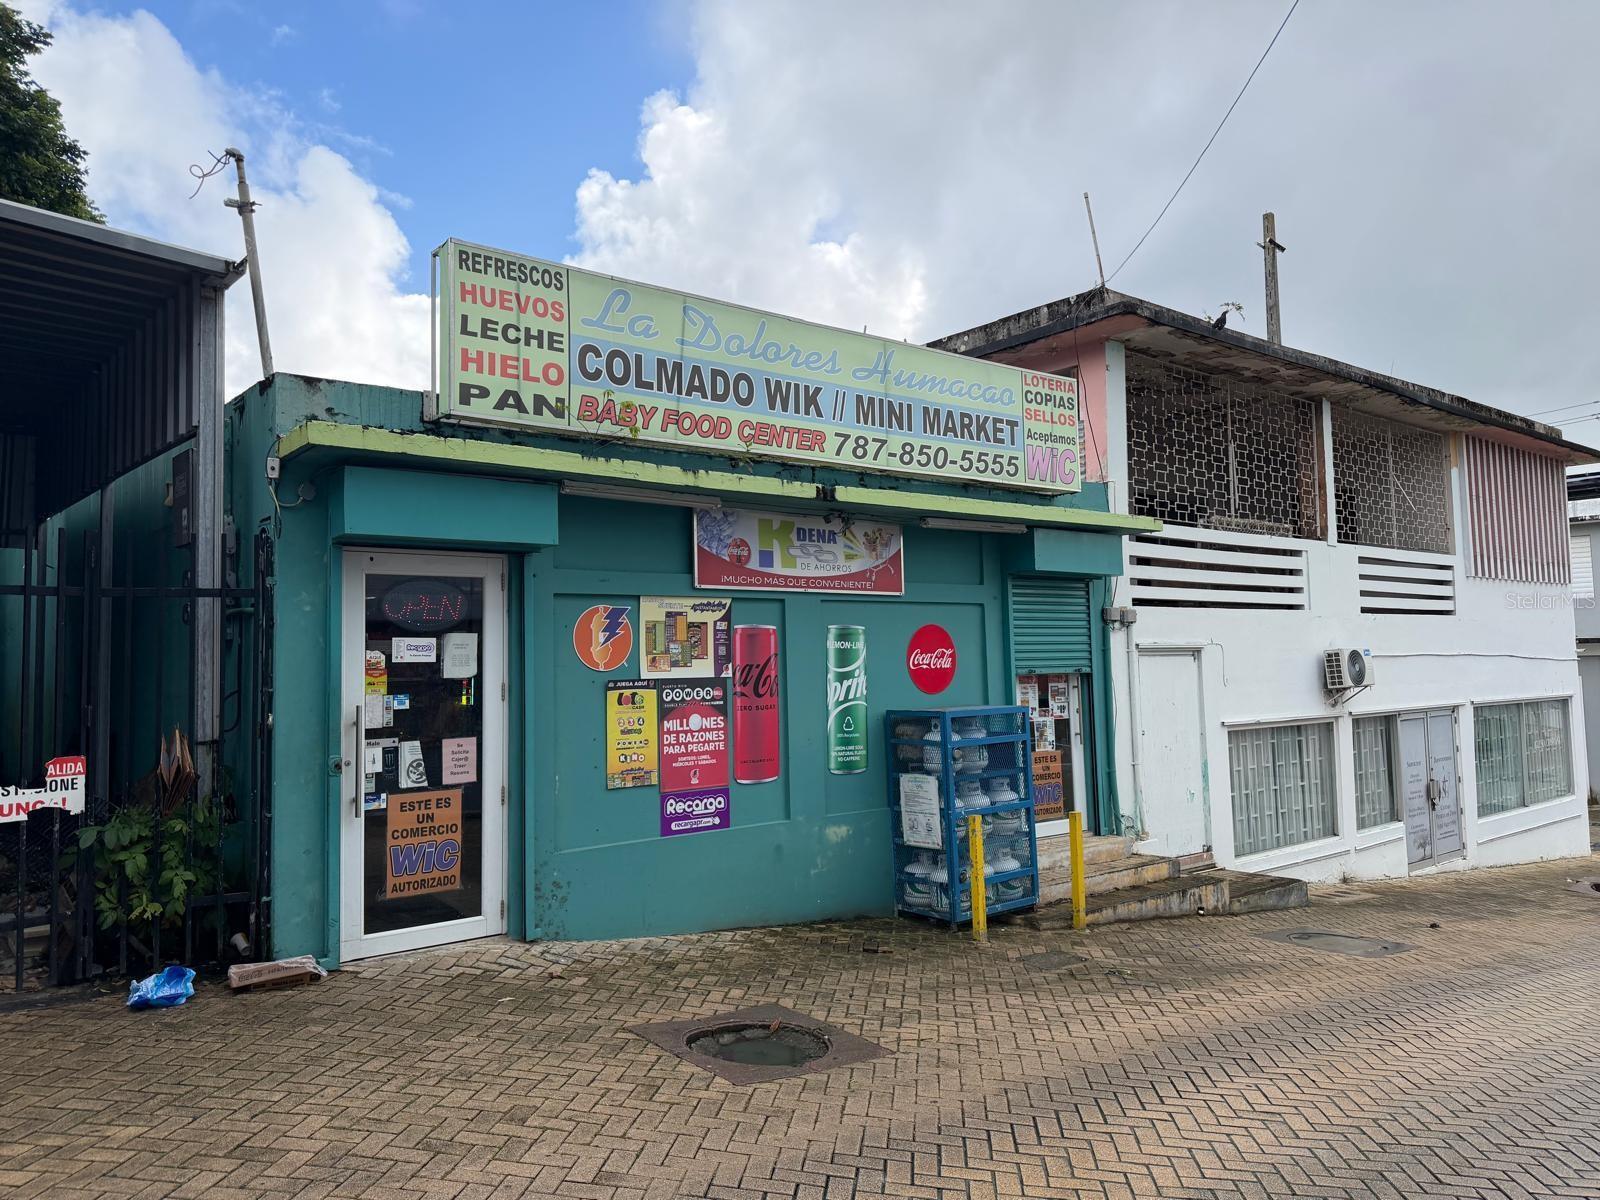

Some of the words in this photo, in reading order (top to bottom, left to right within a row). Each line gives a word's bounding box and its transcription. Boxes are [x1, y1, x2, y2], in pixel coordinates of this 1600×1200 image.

[458, 250, 564, 291] REFRESCOS
[460, 282, 565, 322] HUEVOS
[460, 314, 565, 352] LECHE
[580, 288, 660, 340] La
[676, 304, 842, 374] Dolores
[851, 350, 1016, 407] Humacao
[460, 348, 565, 386] HIELO
[1024, 374, 1075, 394] LOTERIA
[458, 382, 566, 419] PAN
[576, 344, 755, 407] COLMADO
[764, 376, 824, 419] WIK
[855, 394, 913, 433] MINI
[922, 405, 1019, 446] MARKET
[1024, 390, 1075, 410] COPIAS
[577, 395, 660, 429] BABY
[661, 408, 732, 440] FOOD
[738, 420, 826, 452] CENTER
[1024, 408, 1076, 427] SELLOS
[1026, 428, 1076, 446] Aceptamos
[833, 432, 1019, 478] 787-850-5555
[796, 527, 837, 544] DENA
[800, 562, 812, 571] DE
[814, 563, 852, 573] AHORROS
[721, 575, 762, 584] ¡MUCHO
[787, 578, 807, 587] QUE
[809, 579, 874, 590] CONVENIENTE!
[910, 648, 954, 670] Coca-Cola
[664, 689, 713, 700] POWER
[664, 714, 724, 732] MILLONES
[664, 734, 676, 744] DE
[679, 731, 724, 743] RAZONES
[664, 745, 686, 754] PARA
[688, 742, 725, 752] PEGARTE
[1032, 772, 1061, 781] COMERCIO
[400, 799, 432, 812] ESTE
[436, 797, 451, 809] ES
[666, 795, 725, 816] Recarga
[416, 813, 434, 824] UN
[391, 824, 458, 840] COMERCIO
[391, 874, 456, 894] AUTORIZADO
